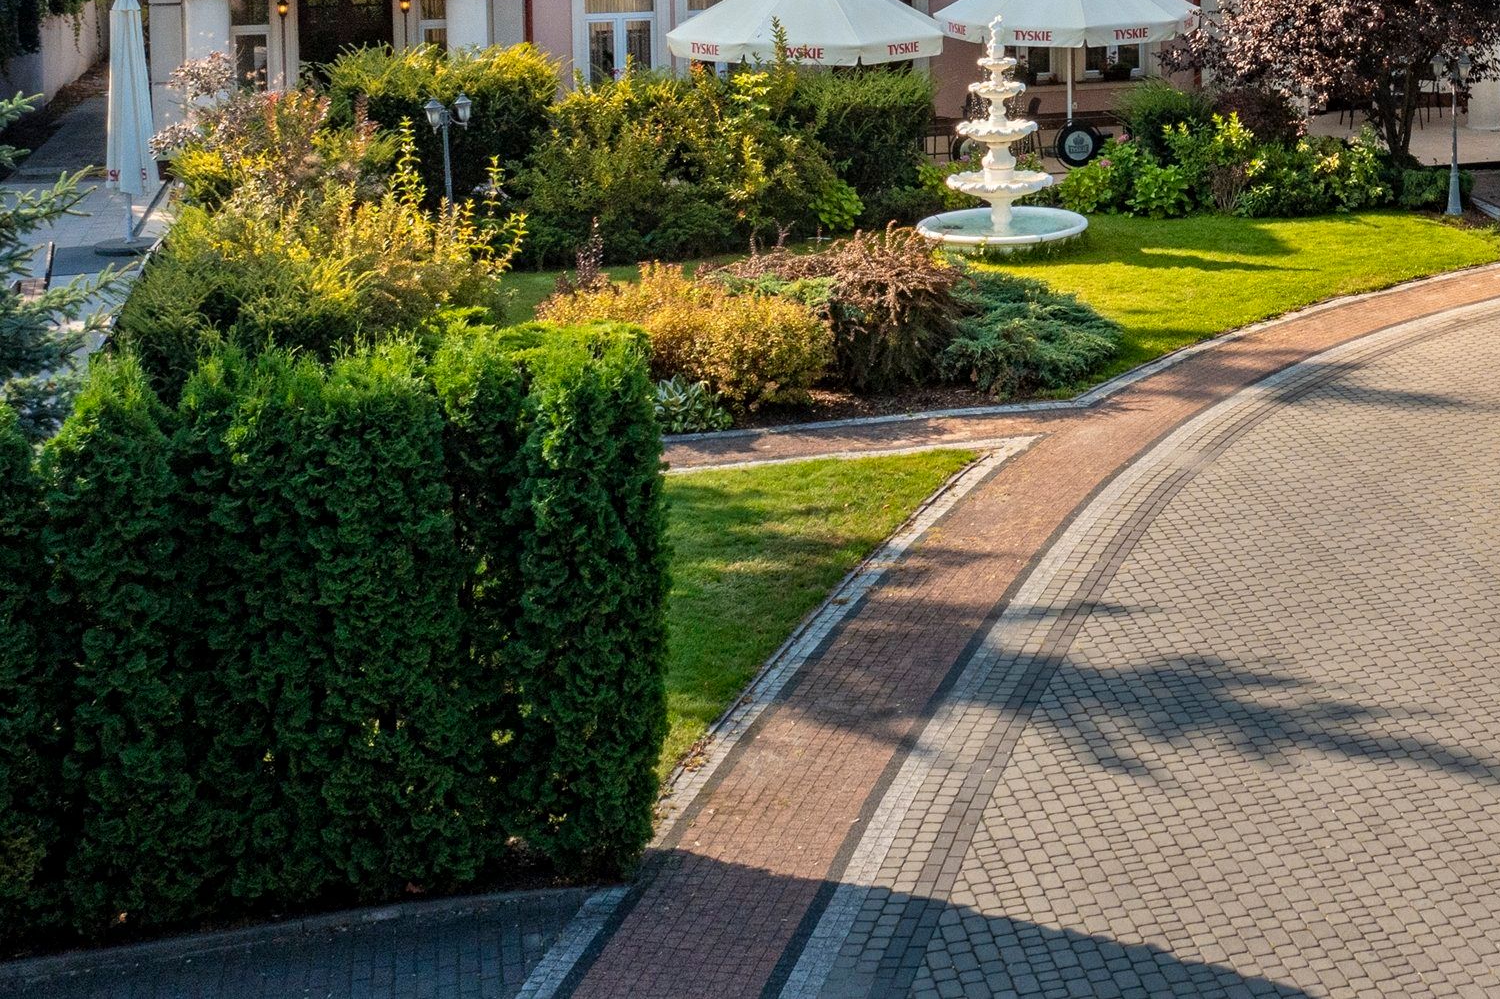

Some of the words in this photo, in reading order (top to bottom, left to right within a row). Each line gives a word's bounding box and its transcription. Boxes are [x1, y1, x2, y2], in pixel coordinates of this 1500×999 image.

[948, 21, 967, 35] TYSKIE
[1113, 27, 1149, 40] TYSKIE
[1013, 29, 1052, 42] TYSKIE
[691, 42, 720, 56] TYSKIE
[887, 41, 920, 55] TYSKIE
